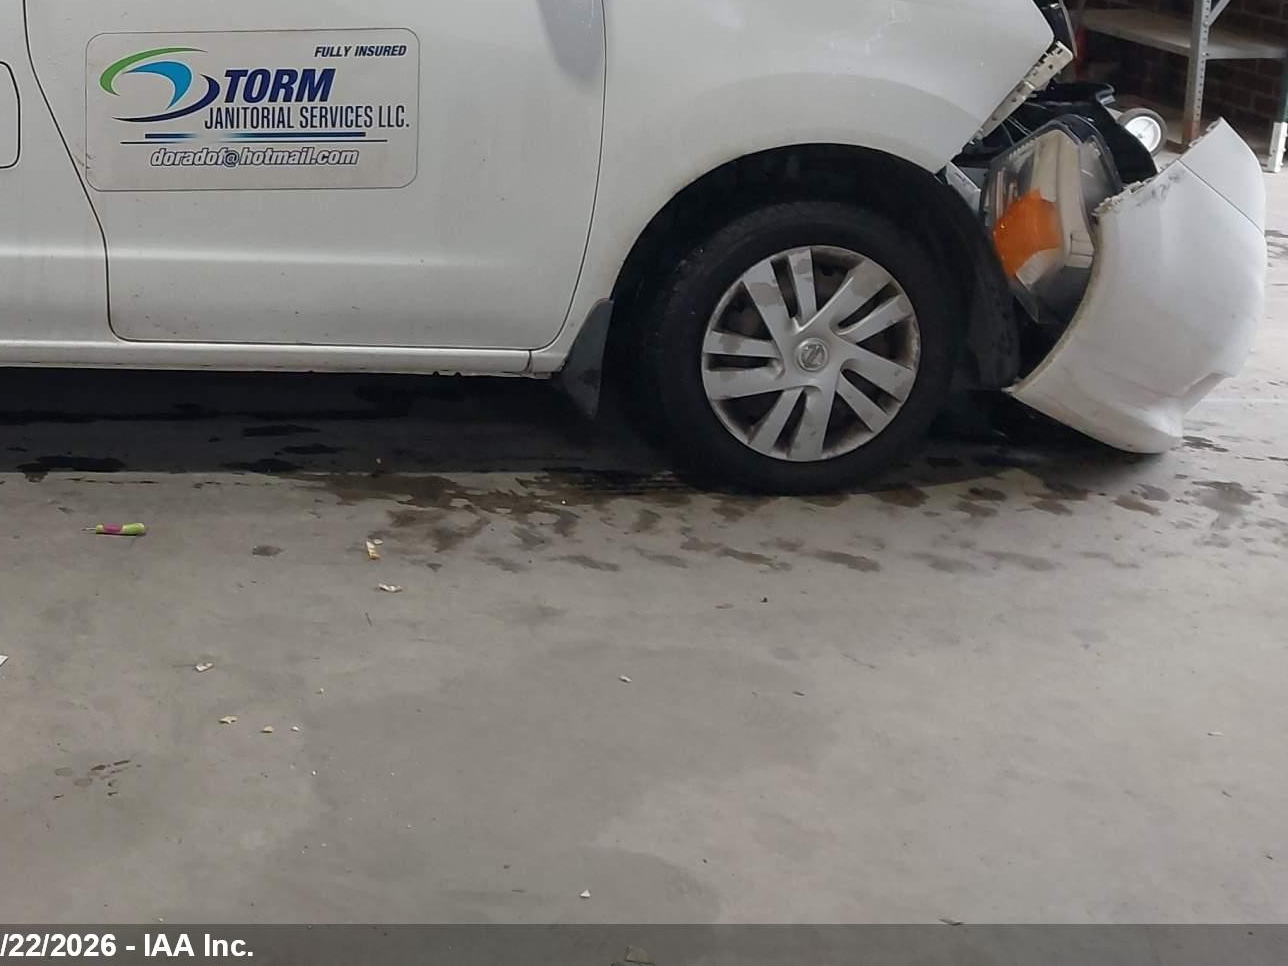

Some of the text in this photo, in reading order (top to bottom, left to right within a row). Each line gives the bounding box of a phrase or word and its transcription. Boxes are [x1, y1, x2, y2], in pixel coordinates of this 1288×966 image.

[314, 45, 407, 58] FULLY INSURED
[204, 105, 410, 129] JANITORIAL SERVICES LLC.
[150, 147, 360, 167] doradof@hotmail.com
